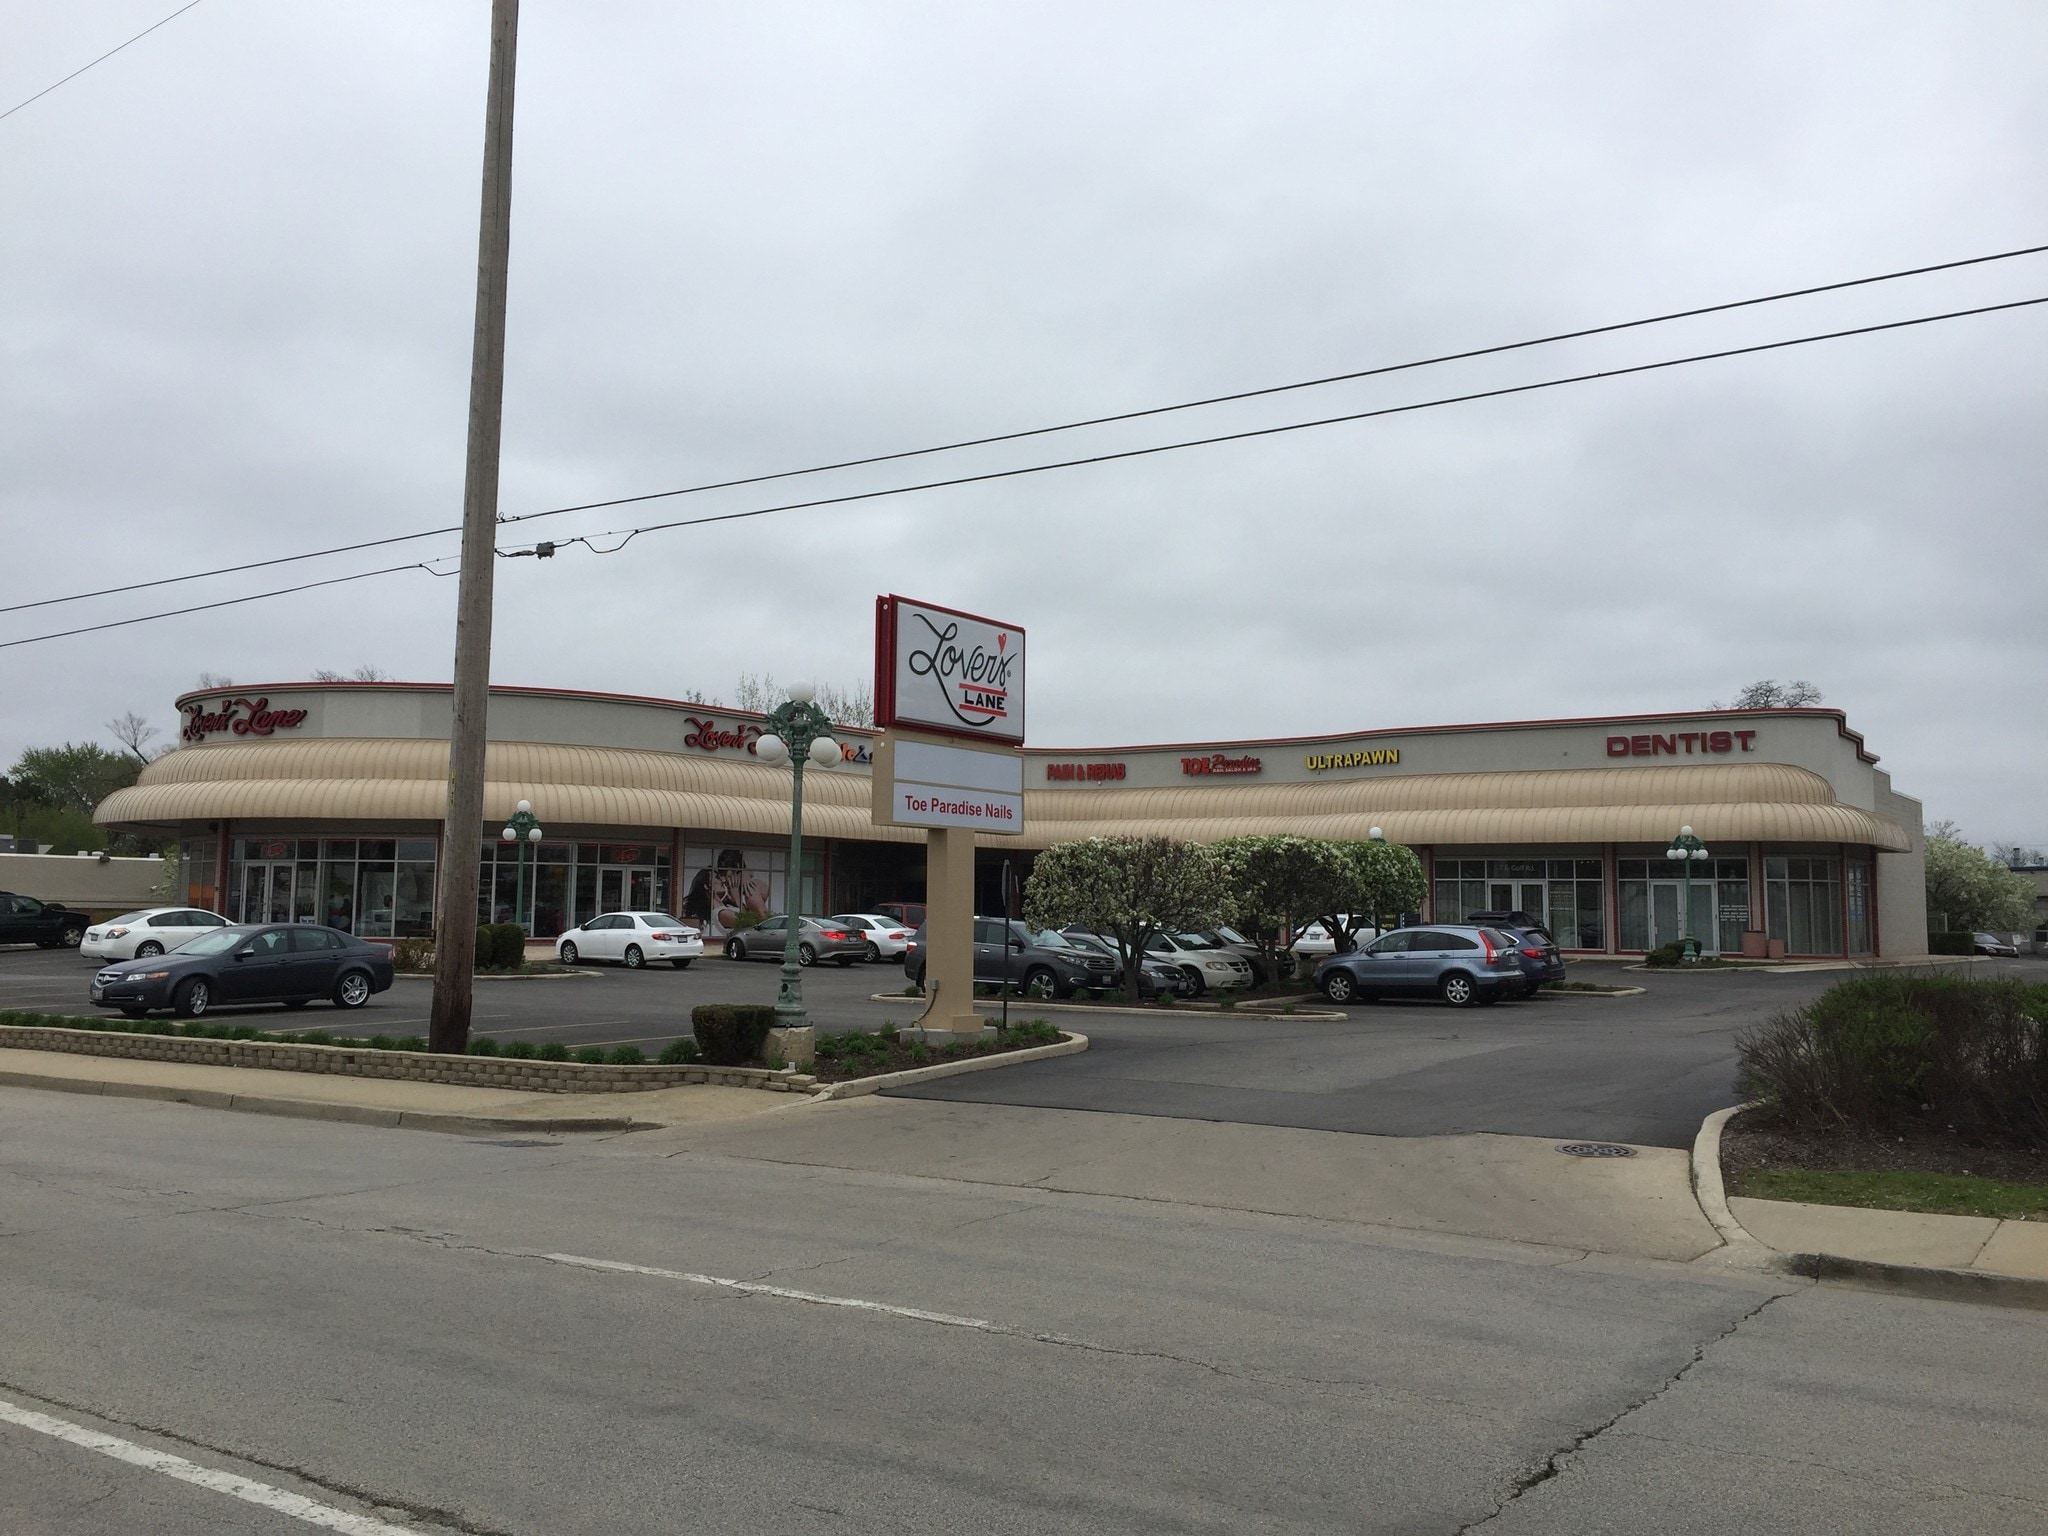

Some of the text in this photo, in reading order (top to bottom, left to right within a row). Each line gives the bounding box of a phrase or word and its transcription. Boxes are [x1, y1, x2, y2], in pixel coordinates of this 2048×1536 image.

[964, 690, 1005, 710] LANE
[231, 697, 307, 735] Lane
[1607, 730, 1755, 757] DENTIST
[1181, 757, 1210, 775] TOE
[1306, 749, 1399, 770] ULTRAPAWN
[1047, 763, 1126, 781] PAIN & REHAB
[905, 795, 1013, 820] Toe Paradise Nails
